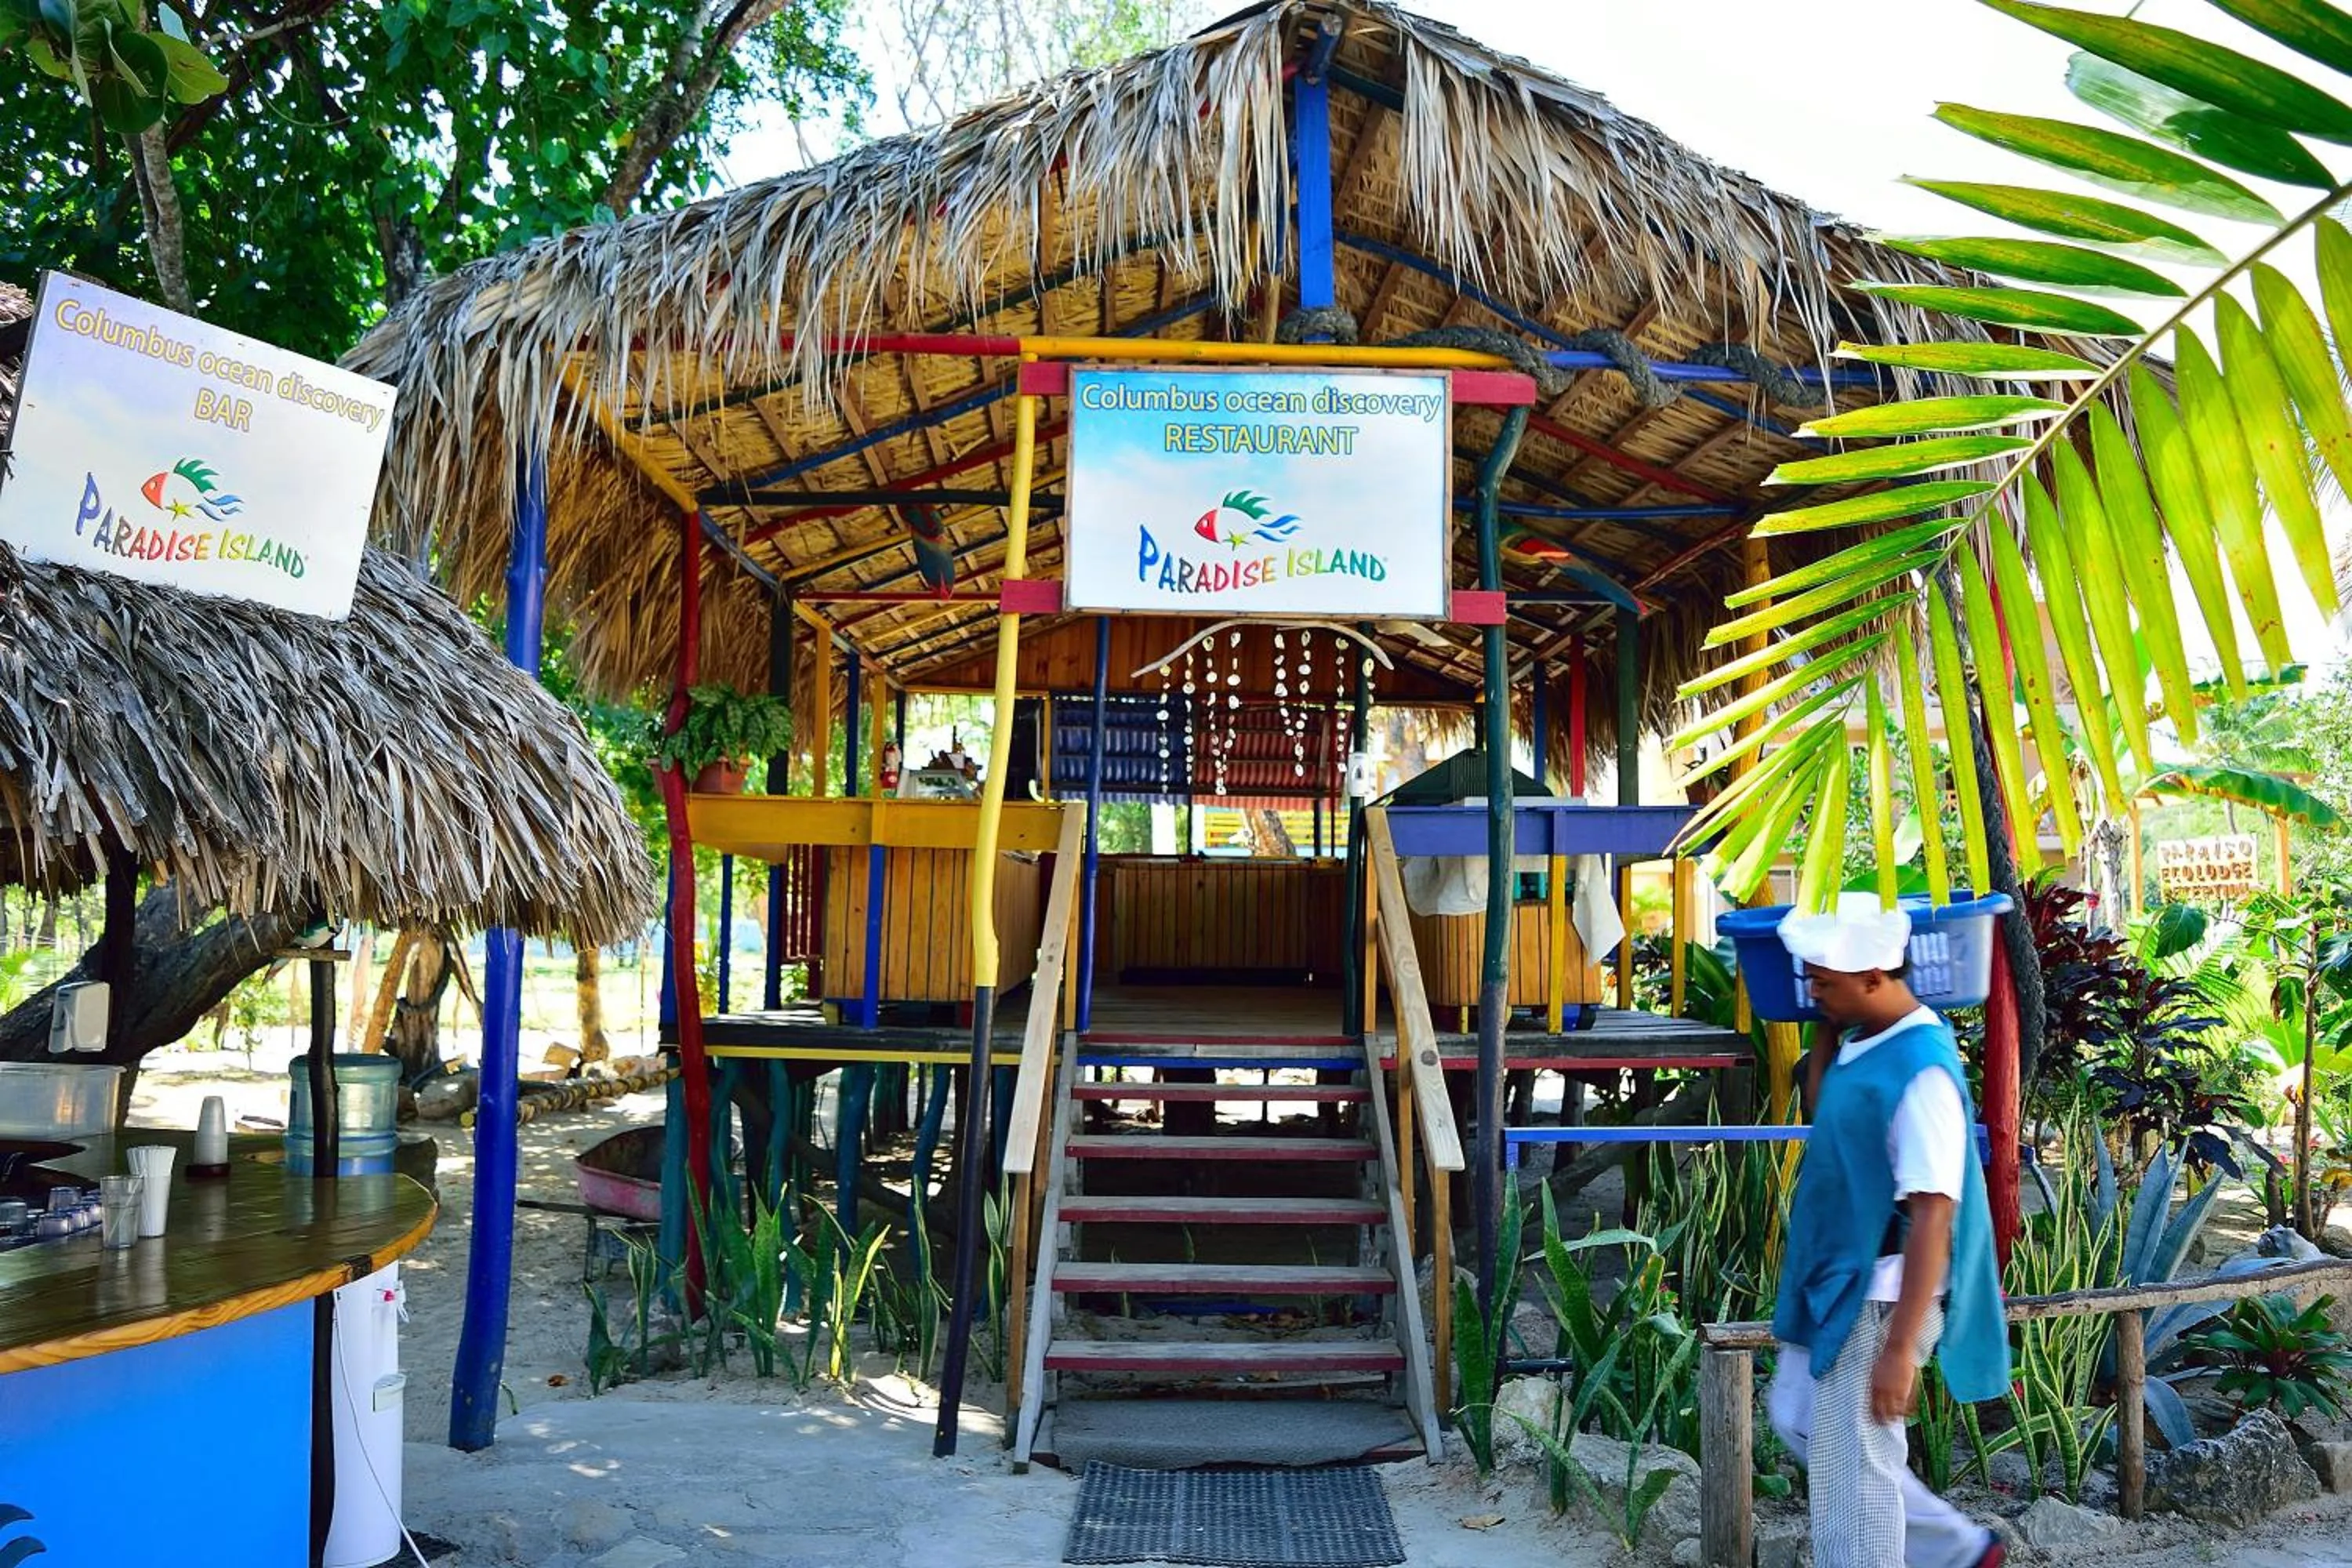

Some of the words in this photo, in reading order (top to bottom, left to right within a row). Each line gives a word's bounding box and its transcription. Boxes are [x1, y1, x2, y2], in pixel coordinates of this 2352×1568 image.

[56, 299, 194, 368] Columbus
[198, 351, 273, 394] ocean
[277, 372, 386, 433] discovery
[194, 388, 253, 432] BAR
[1082, 383, 1218, 411] Columbus
[1225, 390, 1306, 413] ocean
[1312, 387, 1442, 422] discovery
[1164, 424, 1359, 455] RESTAURANT
[76, 472, 212, 561] PARADISE
[219, 528, 305, 579] ISLAND
[1138, 524, 1277, 593] PARADISE
[1287, 547, 1386, 583] ISLAND
